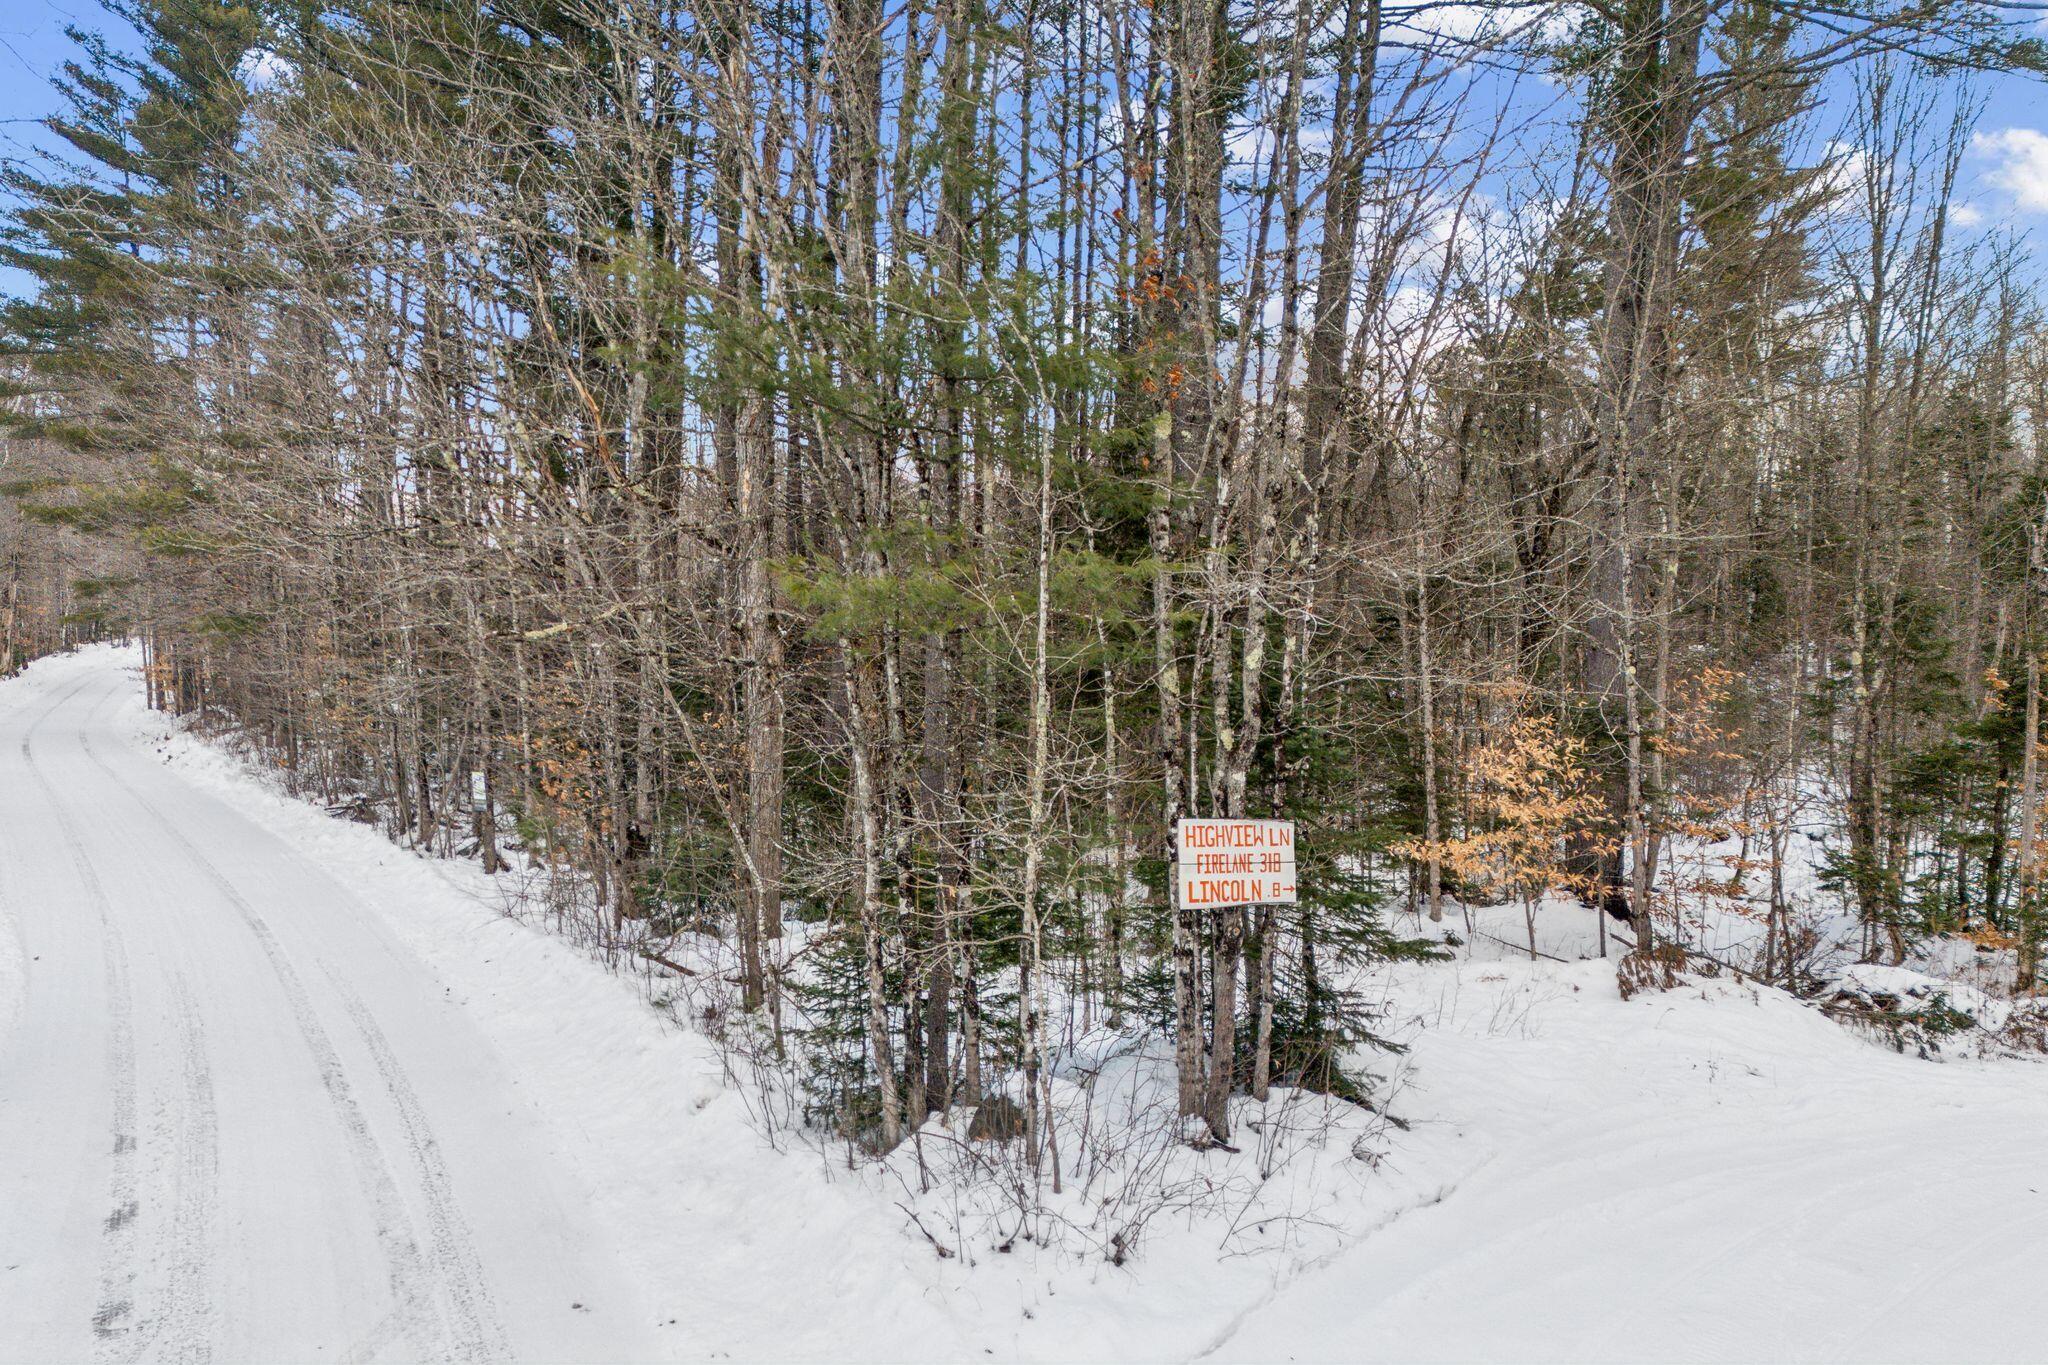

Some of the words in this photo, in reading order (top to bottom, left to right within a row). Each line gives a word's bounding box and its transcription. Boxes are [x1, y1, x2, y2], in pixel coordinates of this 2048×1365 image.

[1185, 824, 1264, 848] HIGHVIEW
[1269, 828, 1290, 846] LN
[1196, 853, 1254, 874] FIRELANE
[1188, 879, 1262, 903] LINCOLN
